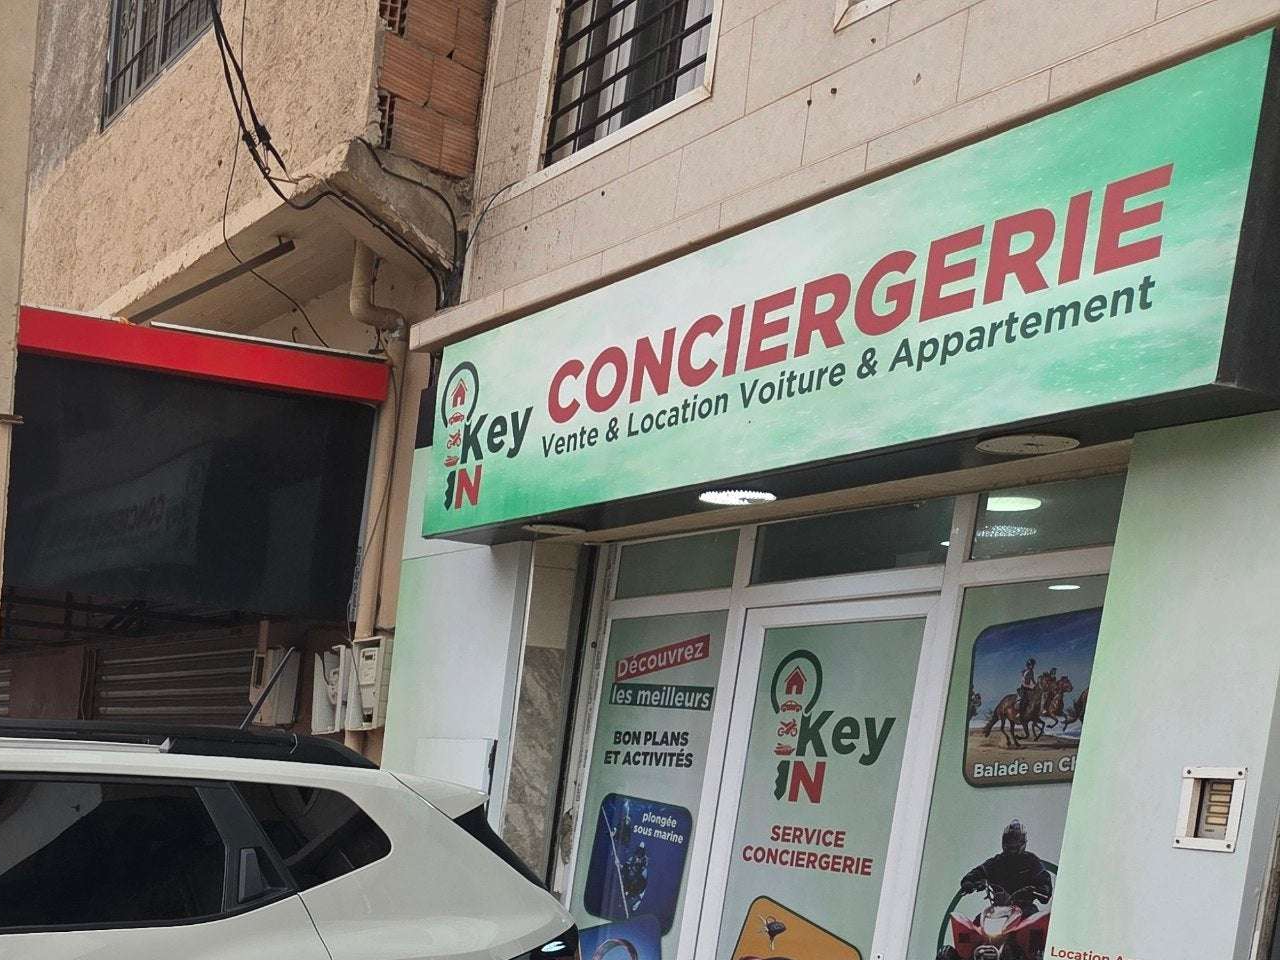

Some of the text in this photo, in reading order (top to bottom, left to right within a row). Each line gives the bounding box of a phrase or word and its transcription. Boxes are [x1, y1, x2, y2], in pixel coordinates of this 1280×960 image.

[548, 163, 1174, 424] CONCIERGERIE
[542, 275, 1156, 458] Vente & Location Voiture & Appartement
[617, 641, 705, 677] Découvrez
[612, 685, 710, 708] les meilleurs
[613, 731, 689, 747] BON PLANS
[604, 748, 694, 768] ET ACTIVITÉS
[973, 760, 1028, 778] Balade
[1033, 760, 1053, 773] en
[642, 811, 677, 828] plongée
[633, 824, 684, 844] sous marine
[770, 825, 846, 848] SERVICE
[742, 845, 873, 876] CONCIERGERIE
